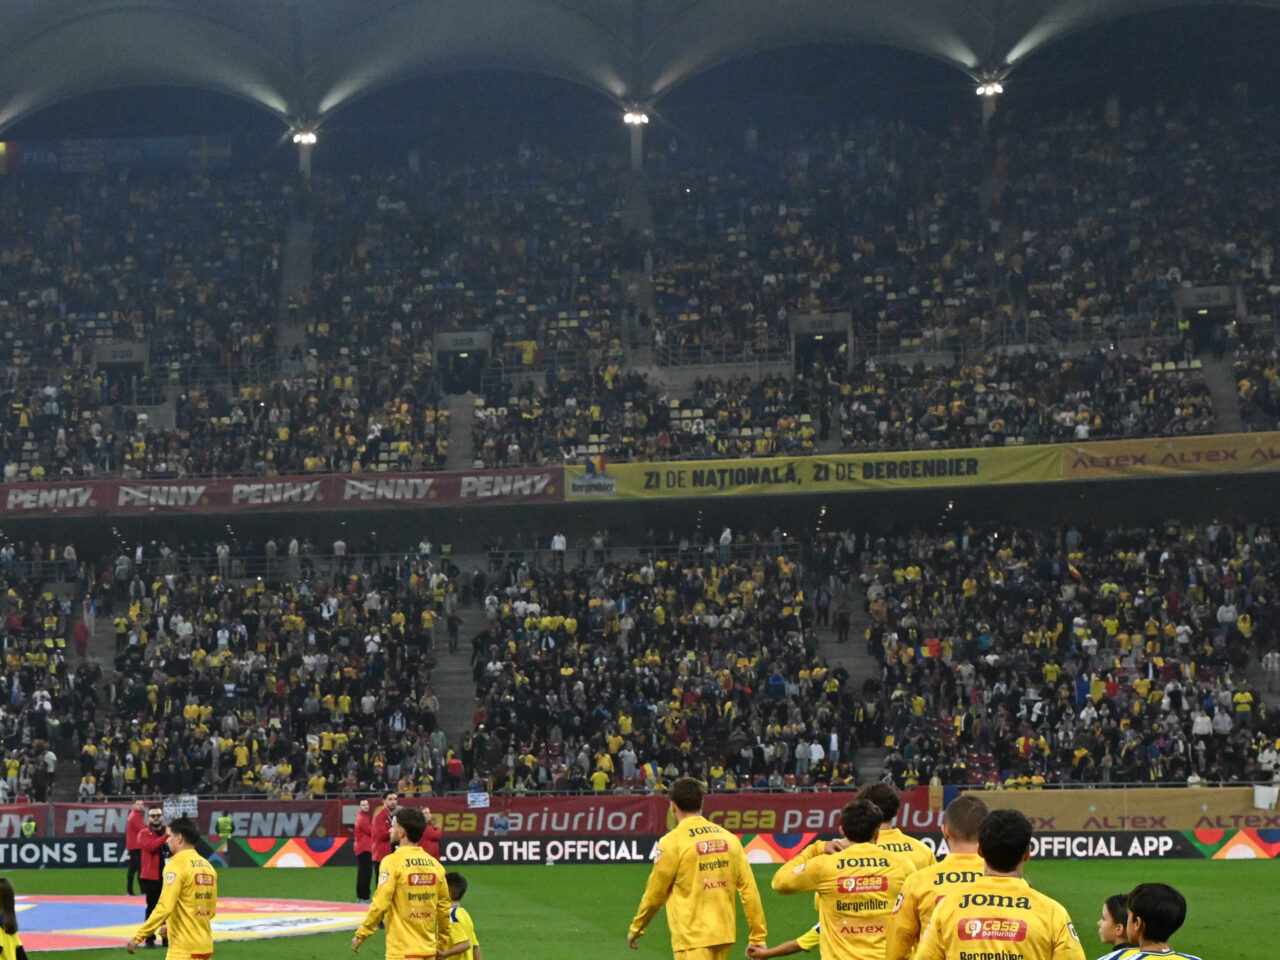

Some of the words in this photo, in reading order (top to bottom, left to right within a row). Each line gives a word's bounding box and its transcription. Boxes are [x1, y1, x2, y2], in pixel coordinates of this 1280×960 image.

[644, 472, 659, 489] ZI
[666, 470, 685, 487] DE
[813, 463, 828, 481] ZI
[836, 462, 855, 479] DE
[862, 457, 978, 478] BERGENBIER
[231, 482, 321, 504] PENNY
[343, 479, 433, 499] PENNY
[459, 474, 549, 497] PENNY
[5, 487, 93, 508] PENNY
[117, 486, 205, 506] PENNY
[65, 808, 128, 833] PEN
[709, 810, 776, 830] casa
[499, 840, 540, 860] THE
[545, 839, 643, 859] OFFICIAL
[878, 841, 913, 853] ma
[1127, 836, 1173, 856] APP
[856, 877, 883, 886] casa
[933, 871, 983, 886] Jom
[836, 900, 888, 912] Bergenbier
[983, 920, 1020, 931] casa
